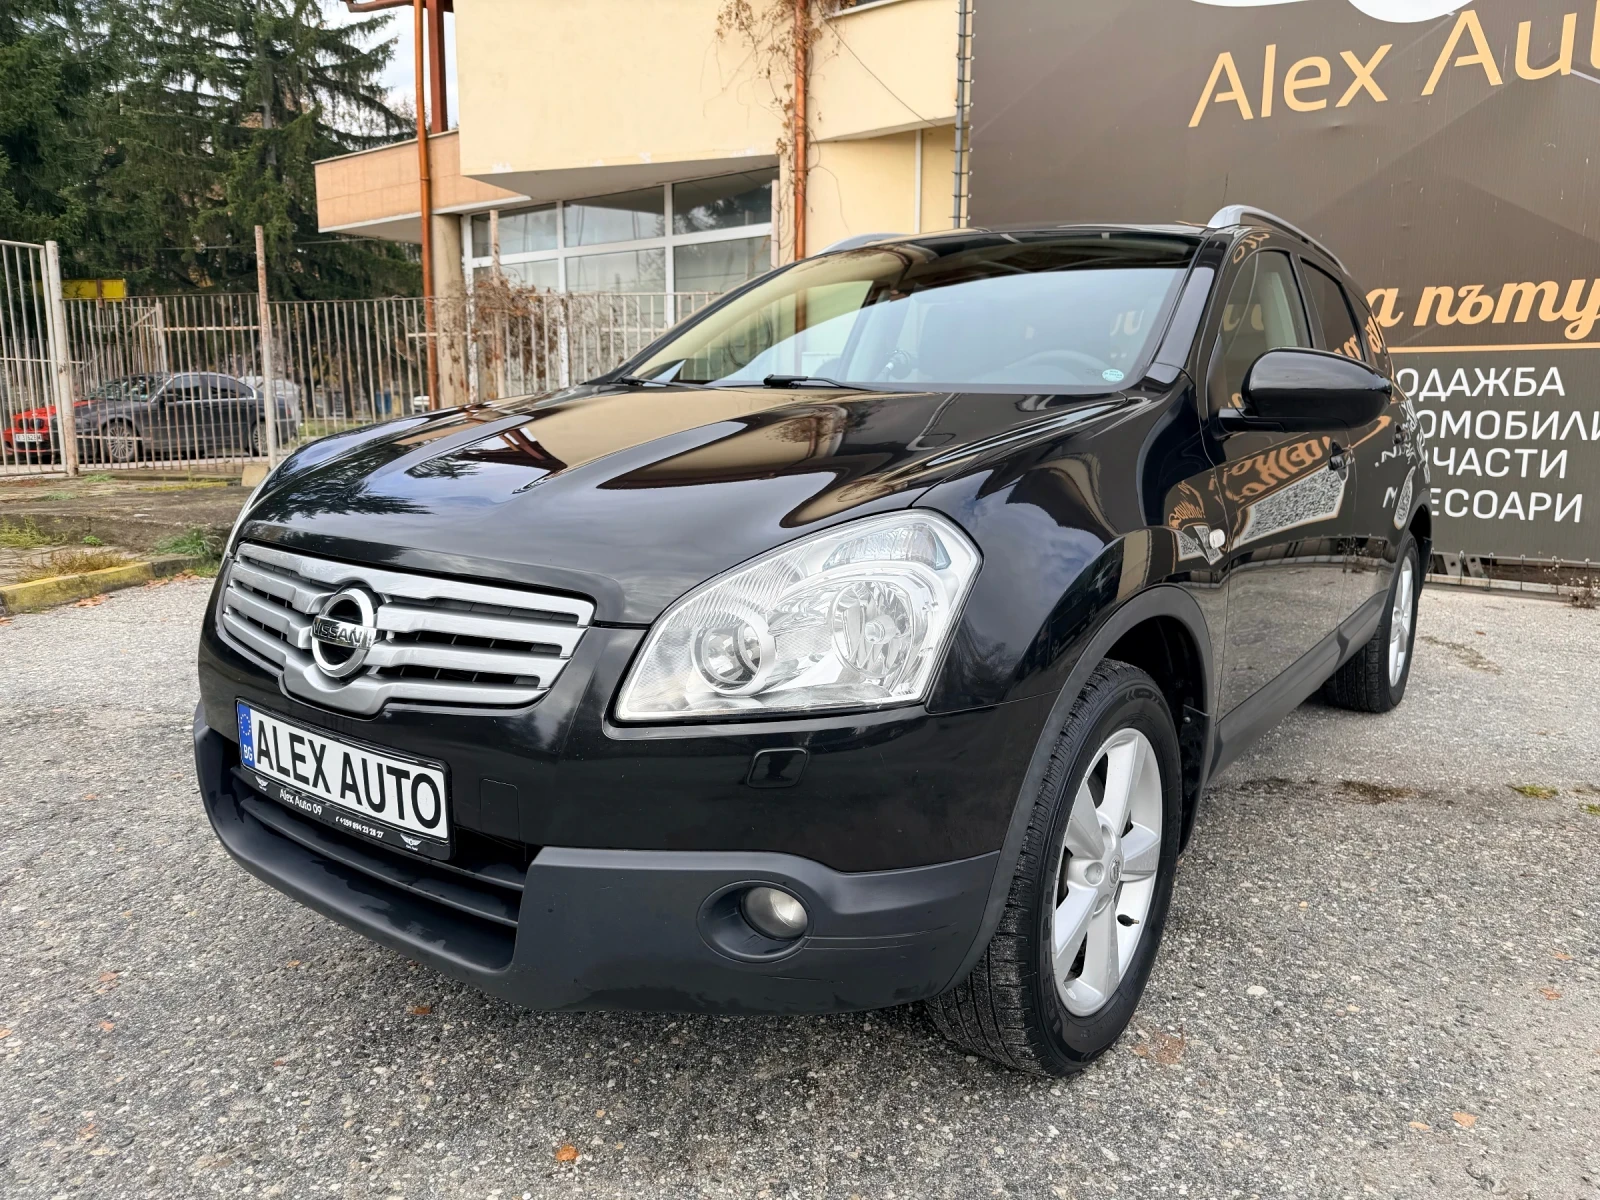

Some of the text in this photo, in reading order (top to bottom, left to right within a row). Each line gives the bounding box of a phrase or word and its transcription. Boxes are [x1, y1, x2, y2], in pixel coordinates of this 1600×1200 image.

[1188, 43, 1394, 128] Alex
[1366, 287, 1404, 328] а
[1396, 366, 1566, 402] ОДАЖБА
[1417, 409, 1600, 442] ОМОБИЛ
[1426, 446, 1568, 479] ЧАСТИ
[1430, 487, 1583, 523] ЕСОАРИ
[313, 621, 363, 648] NISSAN
[243, 744, 253, 762] BG
[256, 719, 442, 830] ALEX AUTO
[279, 788, 294, 805] Alex
[294, 795, 312, 812] Auto
[312, 803, 322, 816] 09
